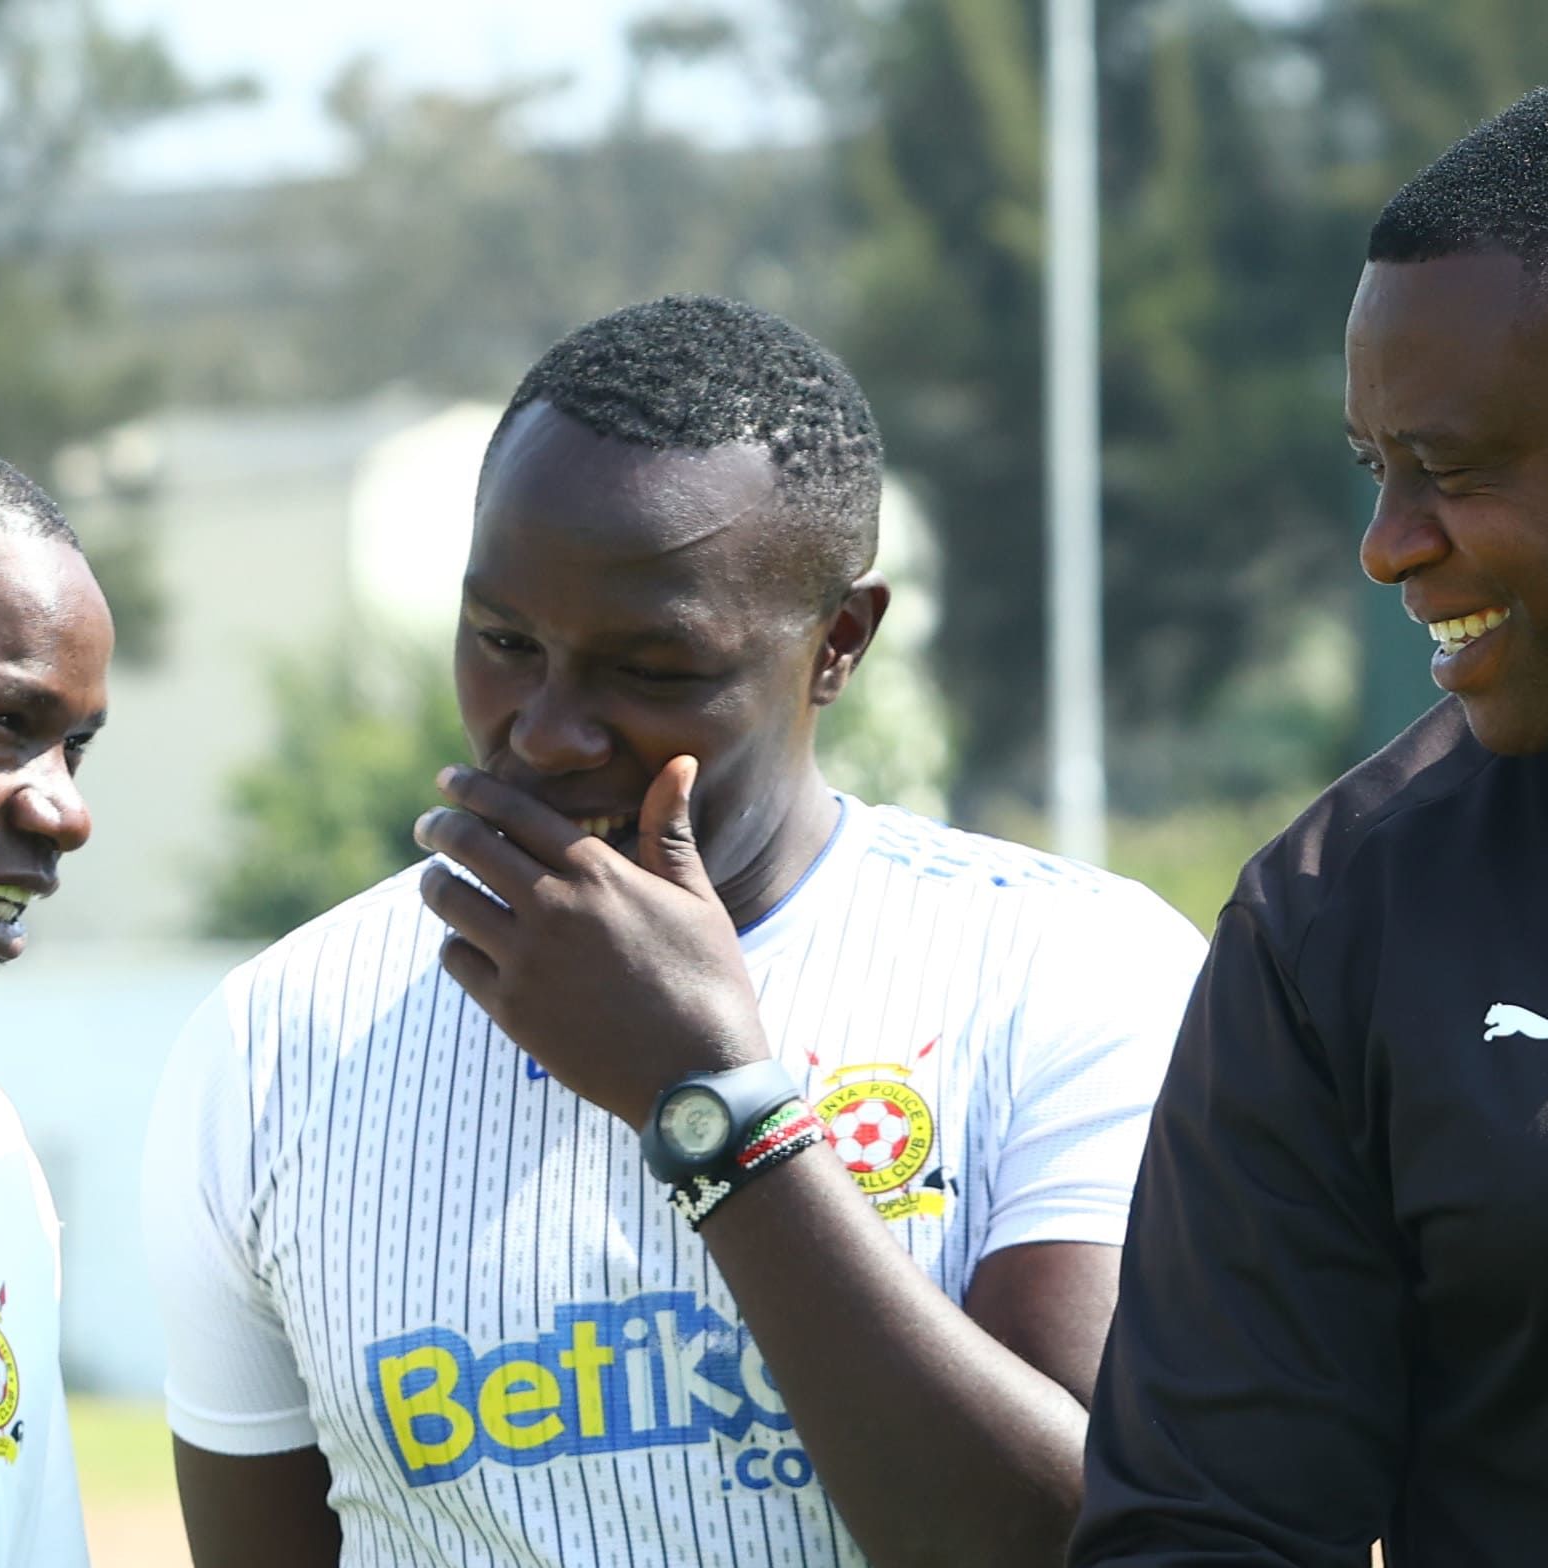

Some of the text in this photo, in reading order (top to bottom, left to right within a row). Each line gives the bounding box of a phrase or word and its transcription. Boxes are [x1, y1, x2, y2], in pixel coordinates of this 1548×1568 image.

[819, 1083, 925, 1125] ENYA POLICE
[892, 1138, 926, 1178] CLUB
[721, 1447, 813, 1491] .co
